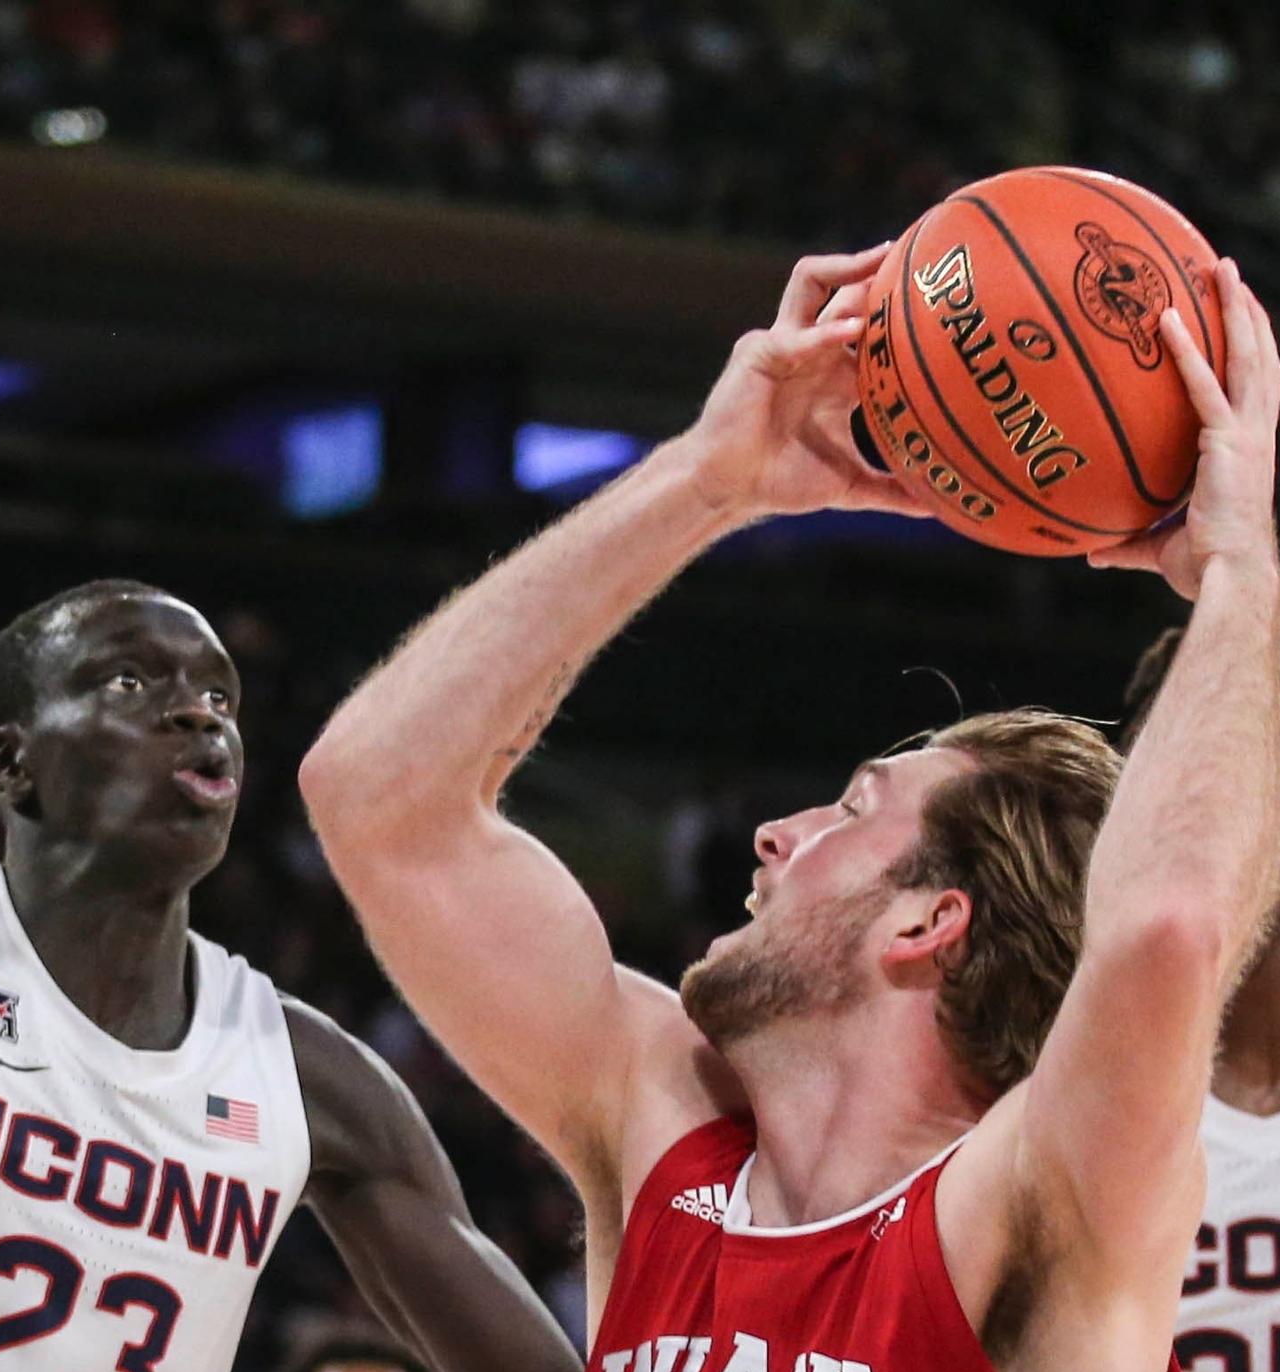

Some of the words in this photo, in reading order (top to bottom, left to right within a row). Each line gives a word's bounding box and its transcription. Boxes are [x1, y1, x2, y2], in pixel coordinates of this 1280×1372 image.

[867, 296, 997, 520] TF-1000
[913, 243, 1088, 489] SPALDING
[671, 1194, 725, 1226] adida
